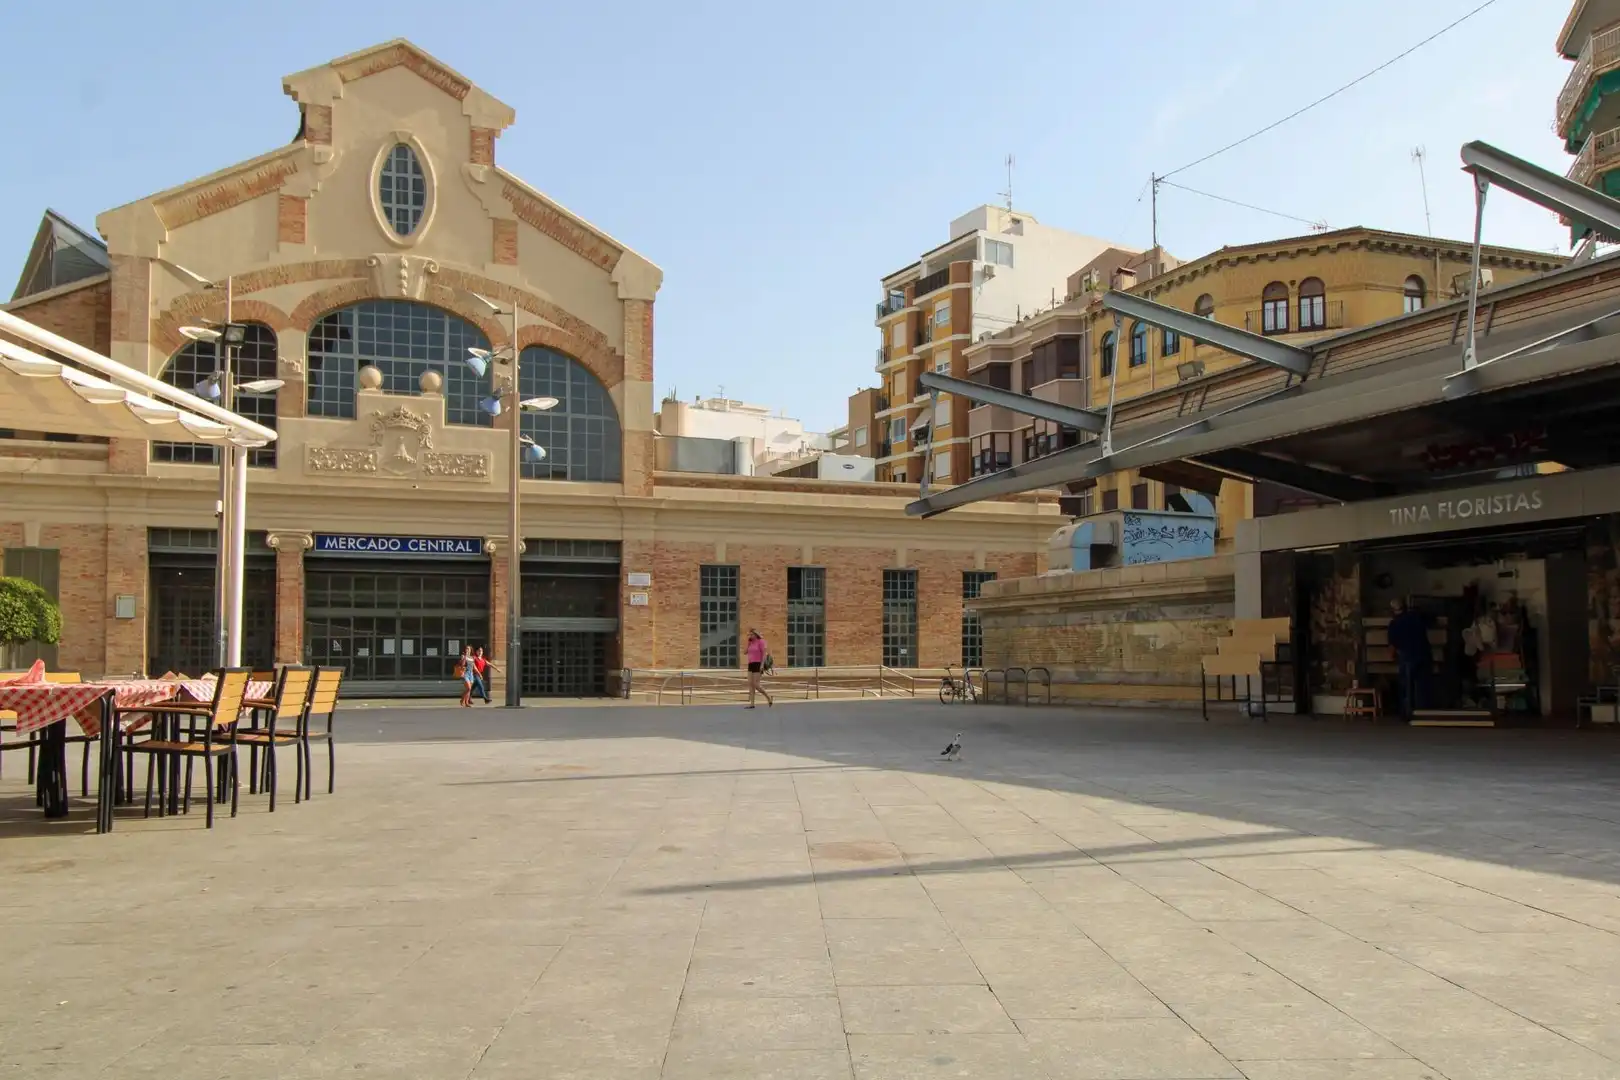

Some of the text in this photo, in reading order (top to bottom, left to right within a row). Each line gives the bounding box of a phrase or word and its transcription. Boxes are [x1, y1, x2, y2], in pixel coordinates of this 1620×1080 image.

[1389, 490, 1543, 525] TINA FLORISTAS
[325, 537, 473, 552] MERCADO CENTRAL
